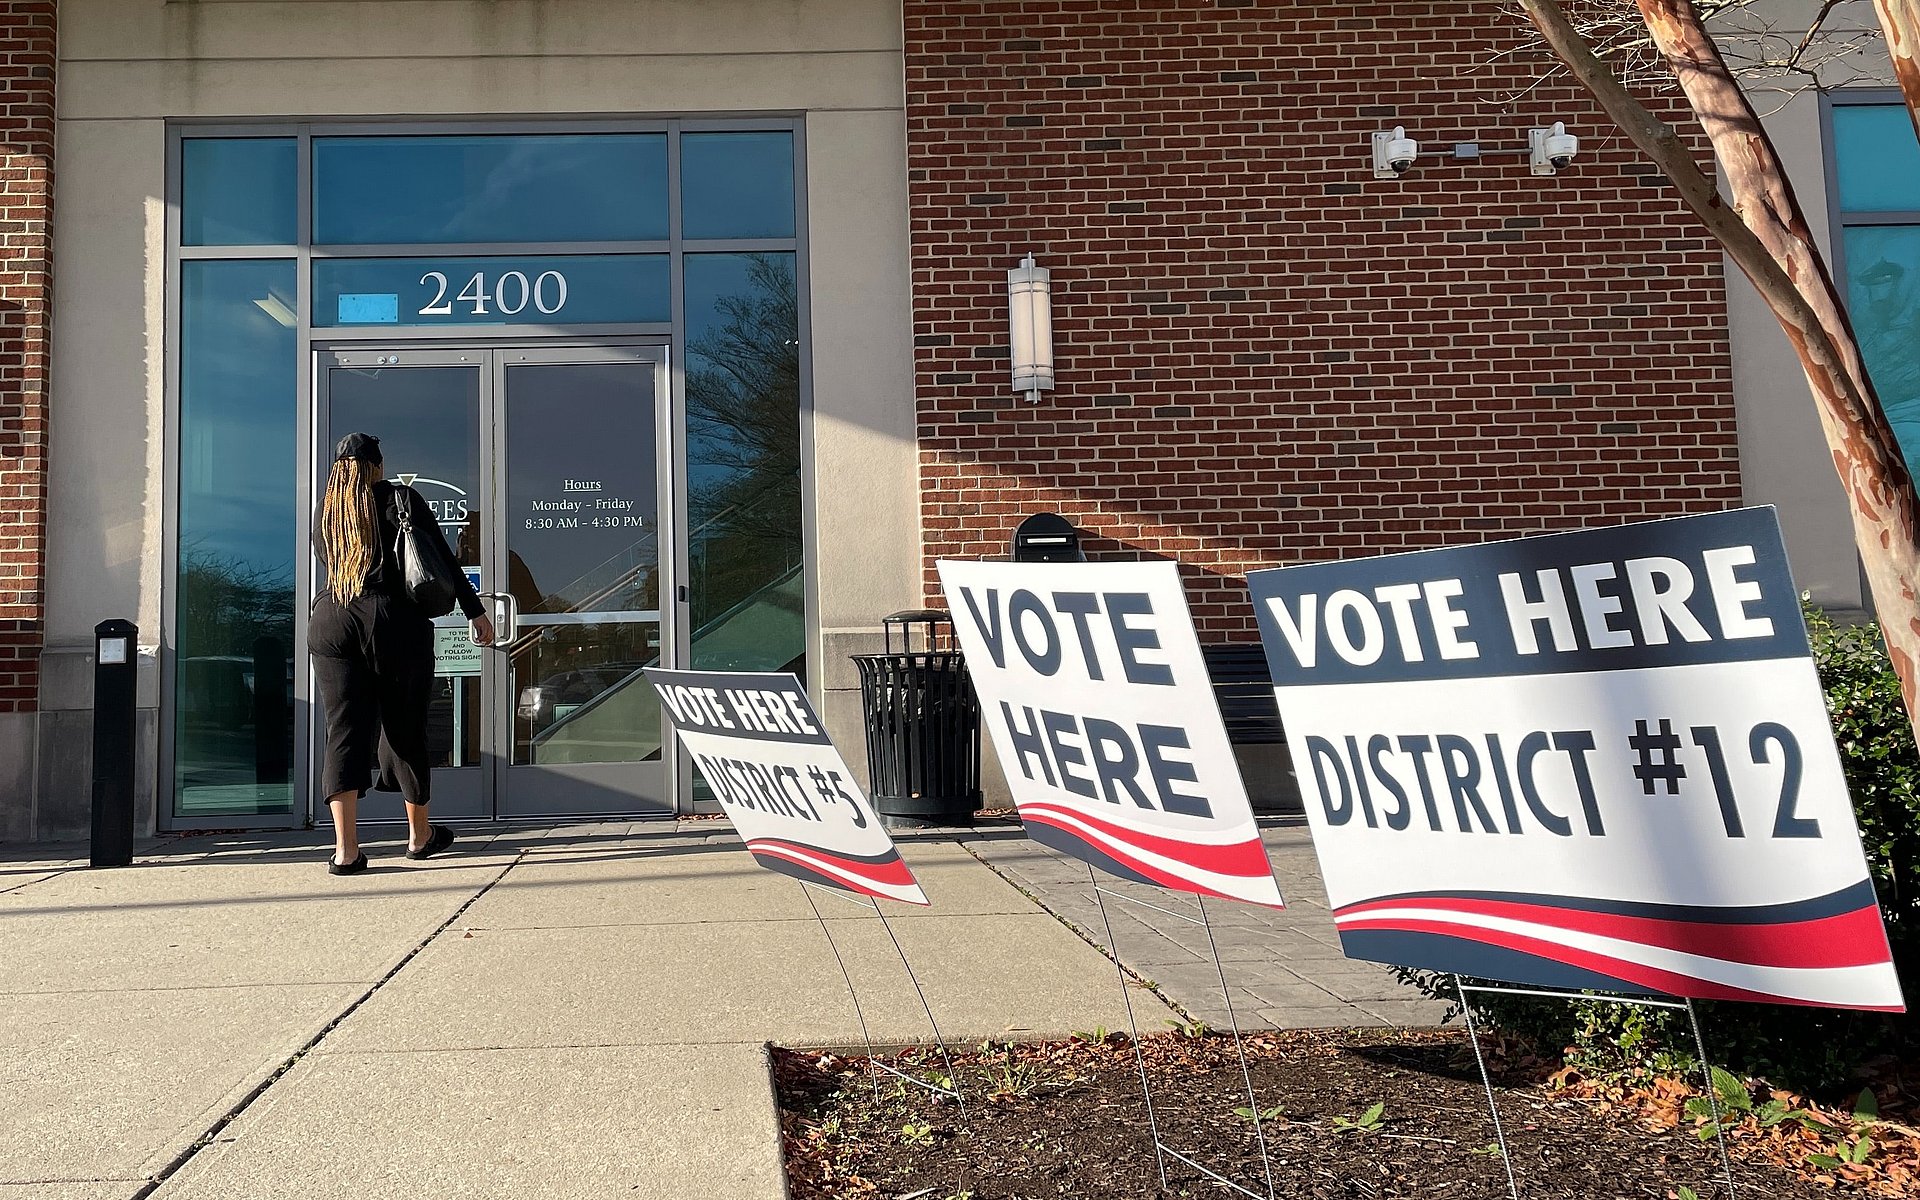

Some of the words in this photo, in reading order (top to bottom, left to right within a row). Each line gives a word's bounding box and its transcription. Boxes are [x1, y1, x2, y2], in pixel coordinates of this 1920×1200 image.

[418, 270, 568, 315] 2400
[532, 499, 582, 512] Monday
[595, 498, 634, 511] Friday
[564, 479, 601, 491] Hours
[525, 518, 553, 529] 8:30
[556, 517, 578, 528] AM
[591, 516, 620, 527] 4:30
[623, 516, 643, 527] PM
[959, 586, 1176, 686] VOTE
[1265, 578, 1480, 669] VOTE
[1498, 545, 1775, 656] HERE
[654, 683, 736, 730] VOTE
[723, 689, 819, 736] HERE
[698, 753, 822, 822] DISTRICT
[806, 764, 867, 829] #5
[999, 700, 1214, 819] HERE
[1305, 729, 1607, 838] DISTRICT
[1628, 718, 1824, 840] #12
